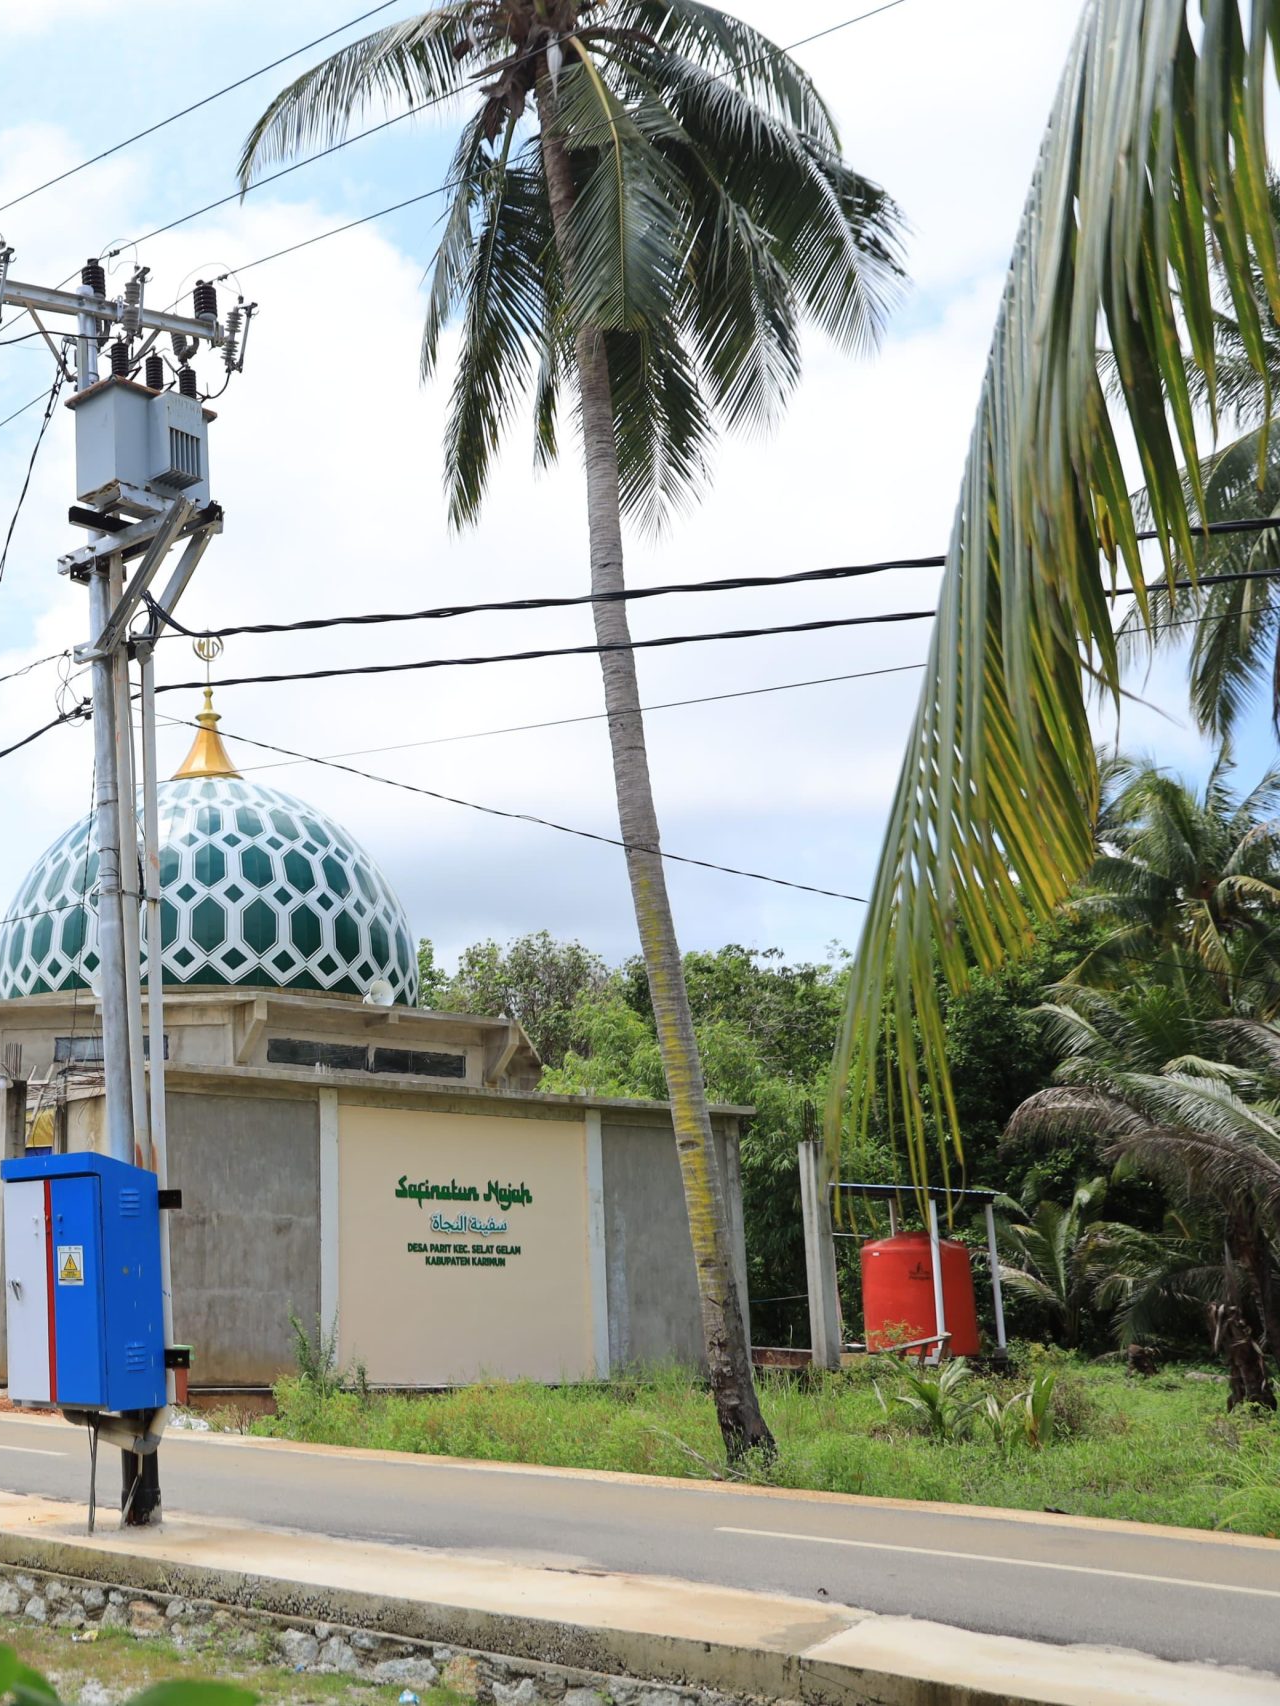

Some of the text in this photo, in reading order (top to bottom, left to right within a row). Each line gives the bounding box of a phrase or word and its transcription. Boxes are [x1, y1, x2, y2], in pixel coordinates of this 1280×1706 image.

[395, 1175, 533, 1211] Safinatun Najah
[432, 1213, 508, 1235] سفينة النجاة
[407, 1242, 521, 1256] DESA PARIT KEC. SELAT GELAM
[425, 1255, 506, 1268] KABUPATEN KARIMUN
